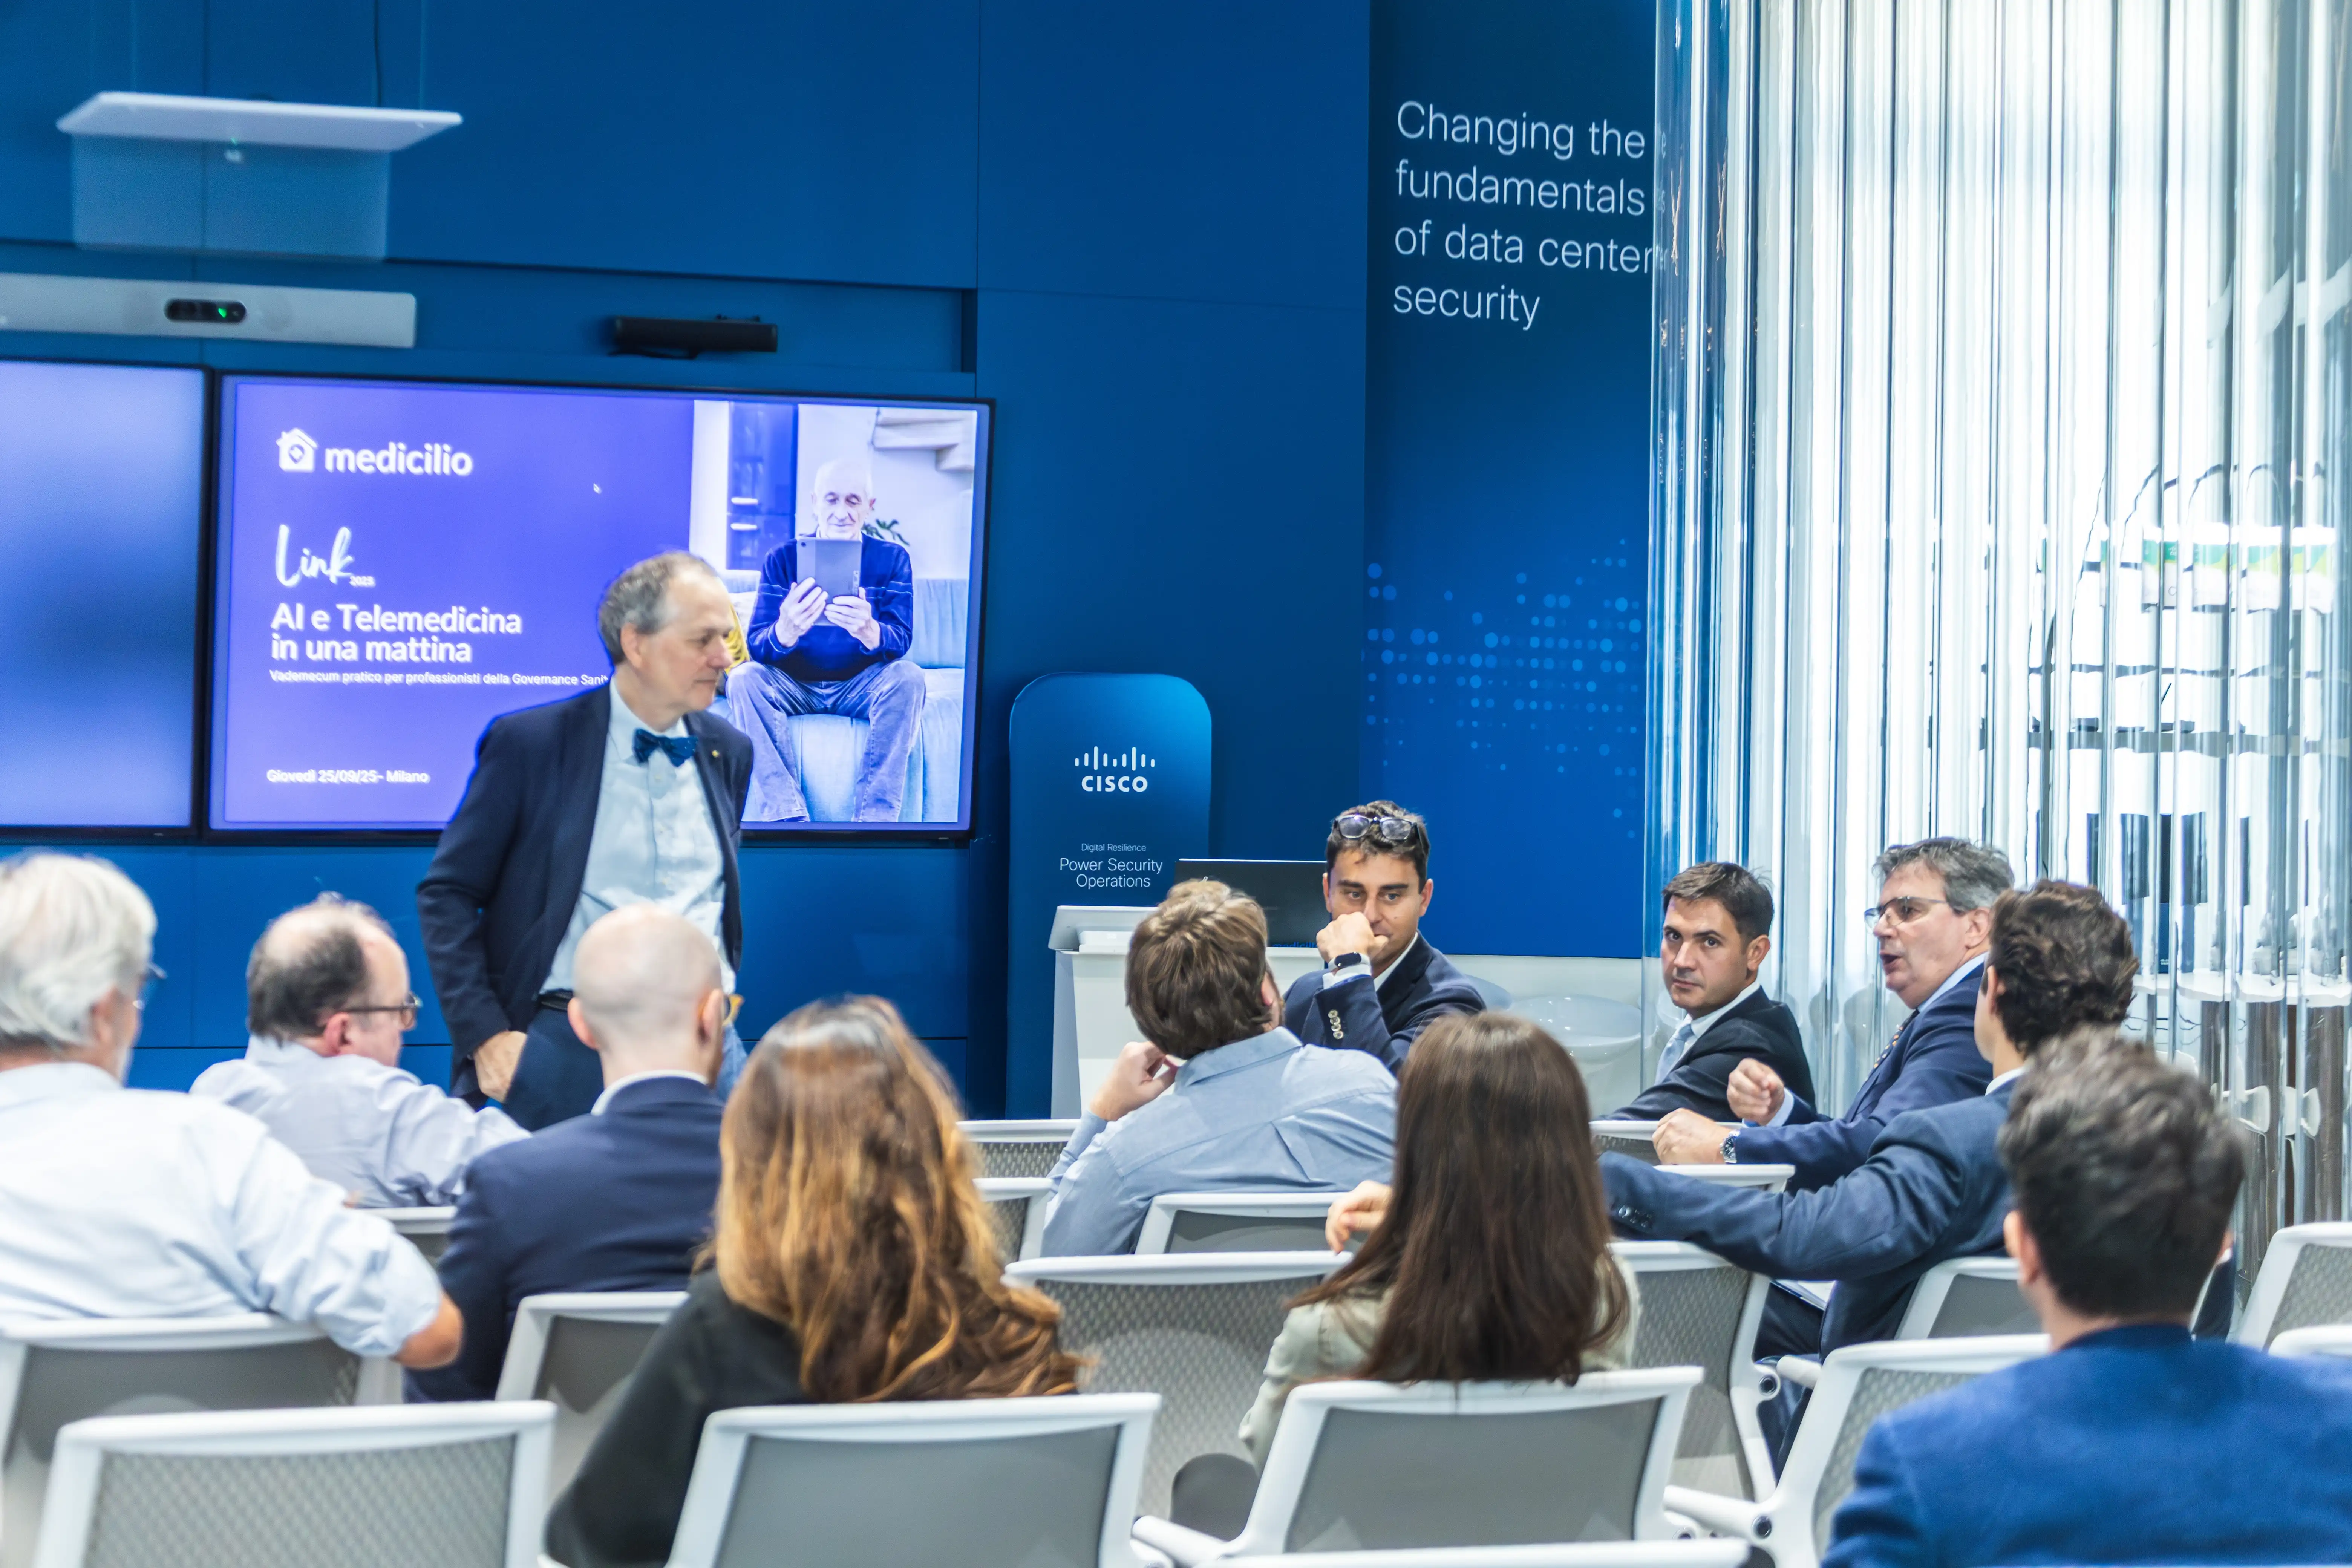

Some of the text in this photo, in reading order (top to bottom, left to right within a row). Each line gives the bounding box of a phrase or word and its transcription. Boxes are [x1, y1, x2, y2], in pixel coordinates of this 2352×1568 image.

[1397, 101, 1645, 161] Changing the
[1396, 159, 1645, 216] fundamentals
[1395, 219, 1654, 274] of data center
[1393, 285, 1540, 331] security
[325, 442, 473, 476] medicilio
[276, 524, 354, 587] Link
[270, 602, 522, 634] AI e Telemedicina
[271, 632, 472, 663] in una mattina
[269, 670, 340, 683] Vademecum
[342, 671, 383, 685] pratico
[384, 672, 404, 685] per
[406, 672, 481, 686] professionisti
[483, 673, 511, 685] della
[512, 673, 579, 686] Governance
[386, 770, 431, 784] Milano
[1081, 775, 1148, 792] CISCO
[1081, 843, 1105, 853] Digital
[1060, 858, 1163, 874] Power Security
[1076, 874, 1151, 890] Operations
